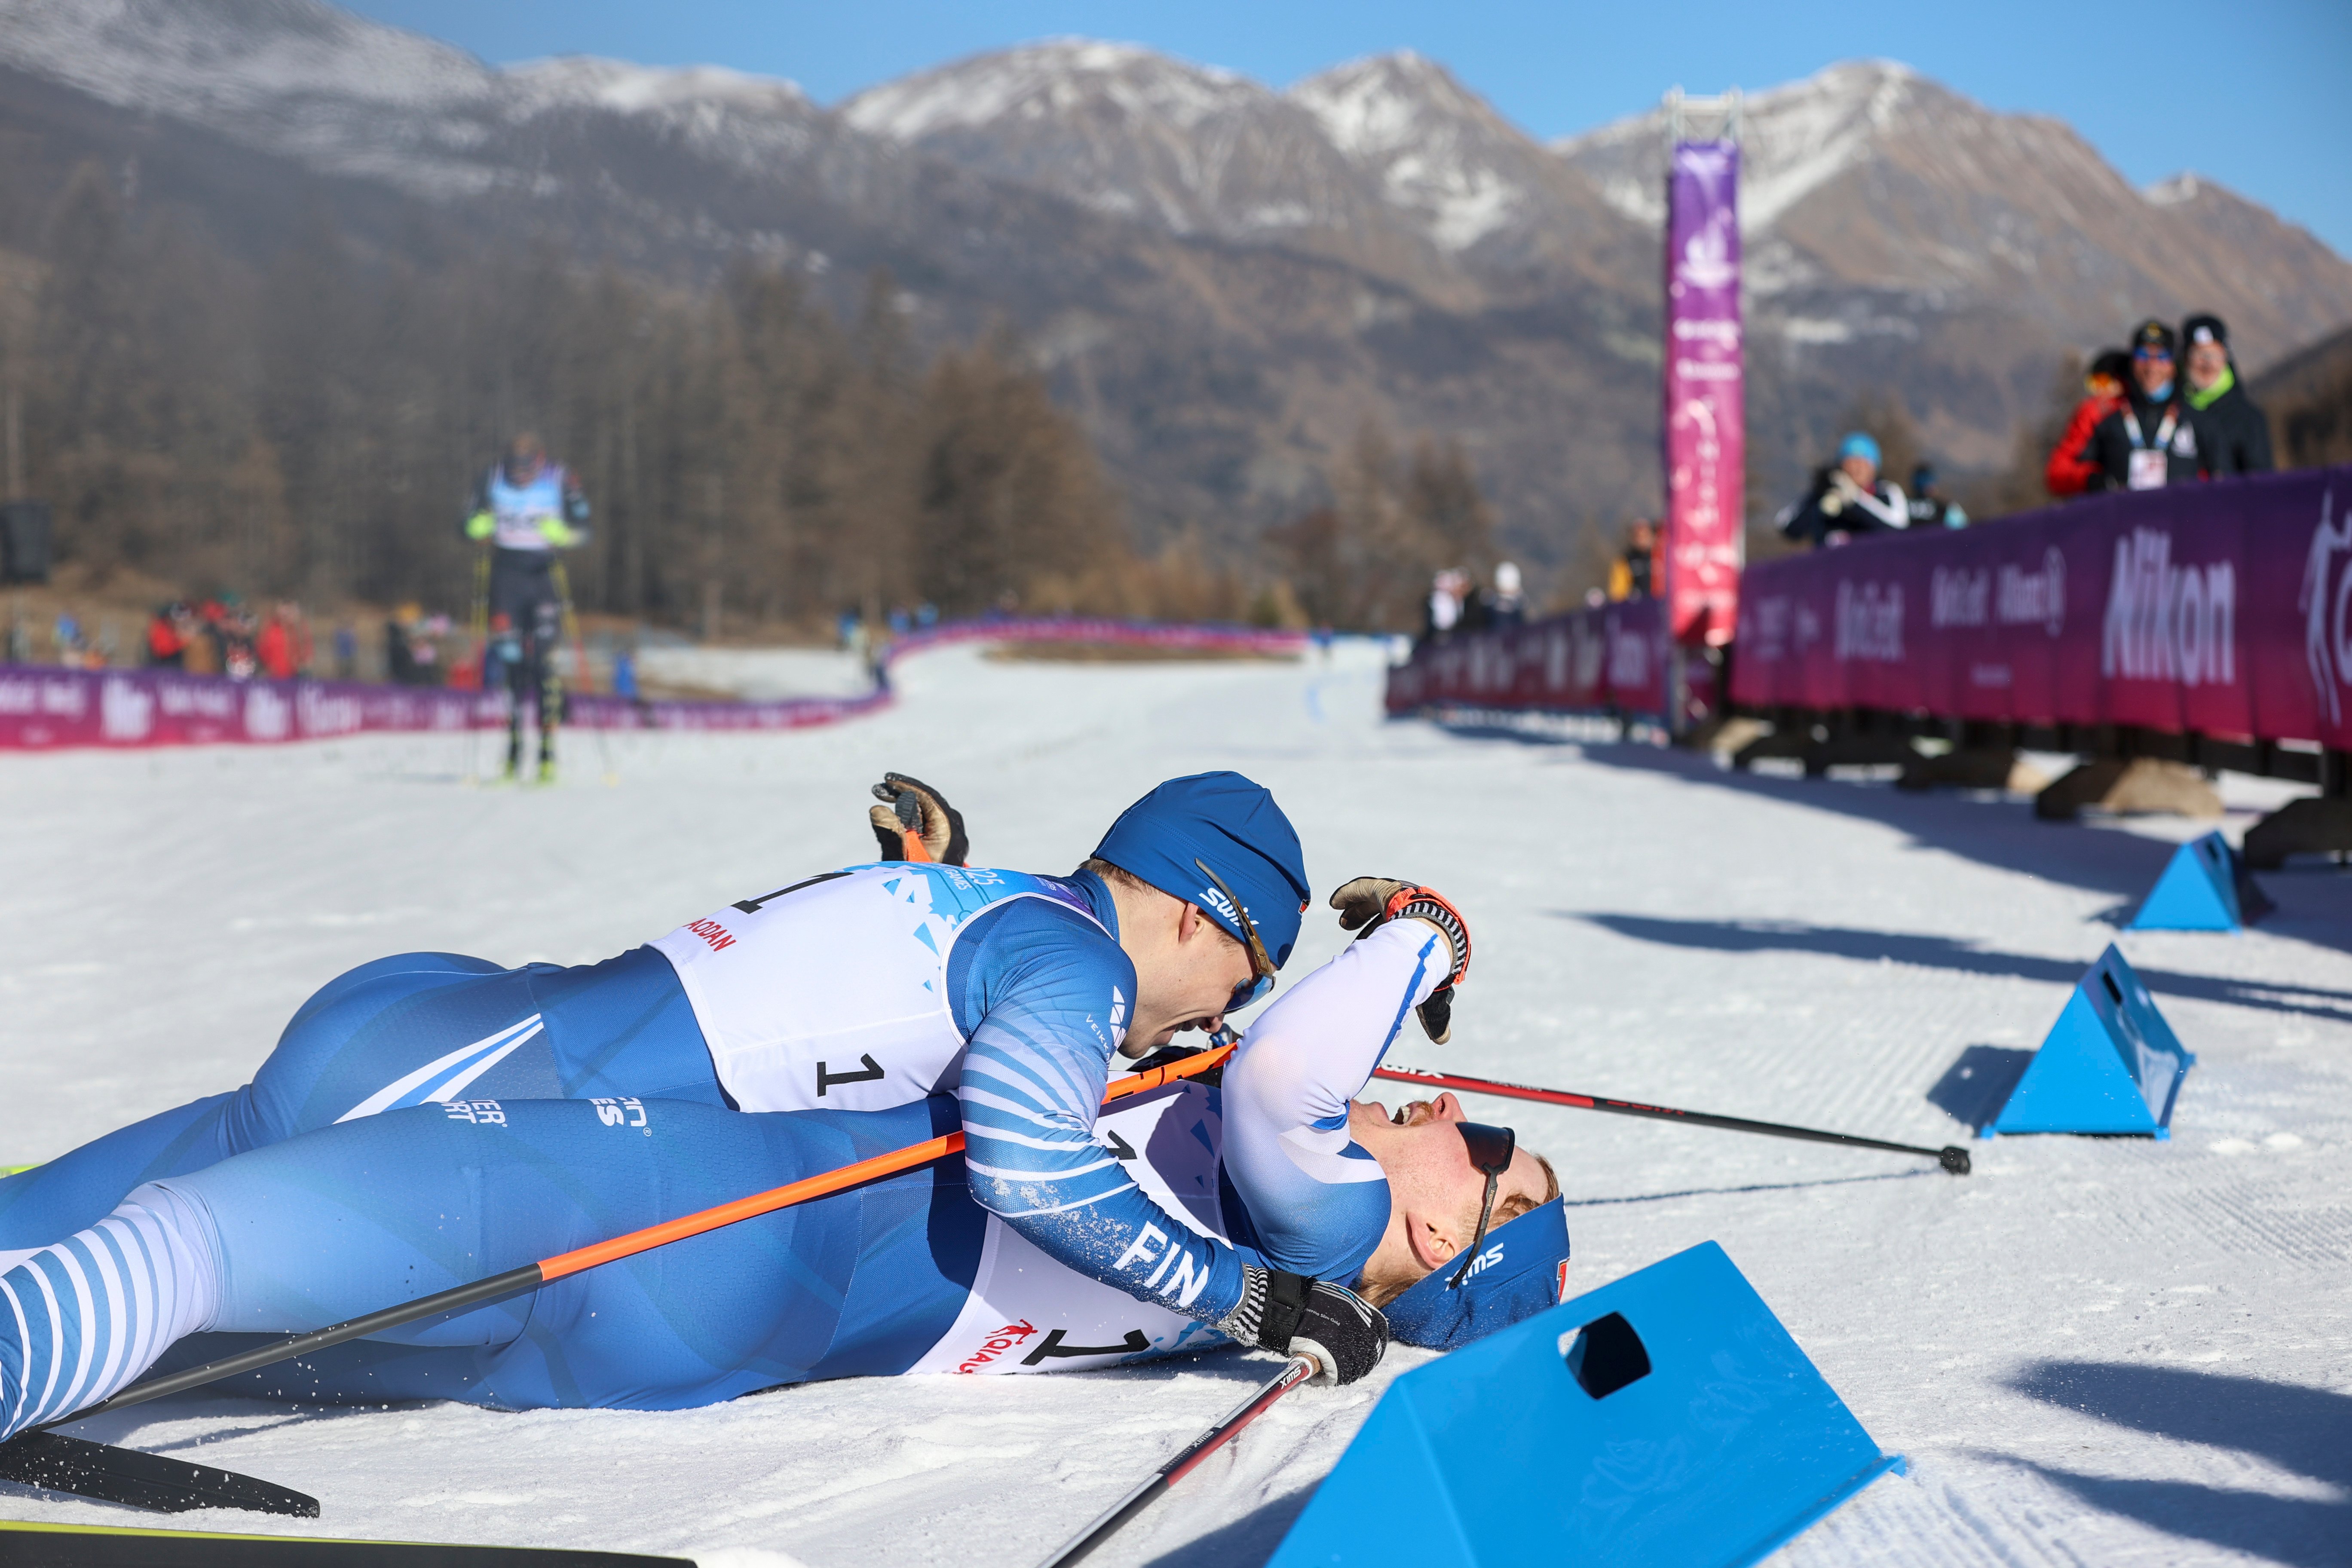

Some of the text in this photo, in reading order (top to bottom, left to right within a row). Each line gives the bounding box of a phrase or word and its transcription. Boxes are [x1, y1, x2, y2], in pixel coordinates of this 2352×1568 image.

[2102, 527, 2235, 685] Nikon
[944, 869, 973, 890] GAMES
[960, 867, 1006, 885] 025
[730, 872, 854, 915] 1
[682, 918, 737, 952] AODAN
[817, 1053, 885, 1097] 1
[438, 1100, 477, 1124] ORT
[467, 1099, 506, 1124] TER
[1113, 1221, 1209, 1308] FIN
[1330, 1317, 1341, 1326] Gold
[1020, 1329, 1151, 1366] 1
